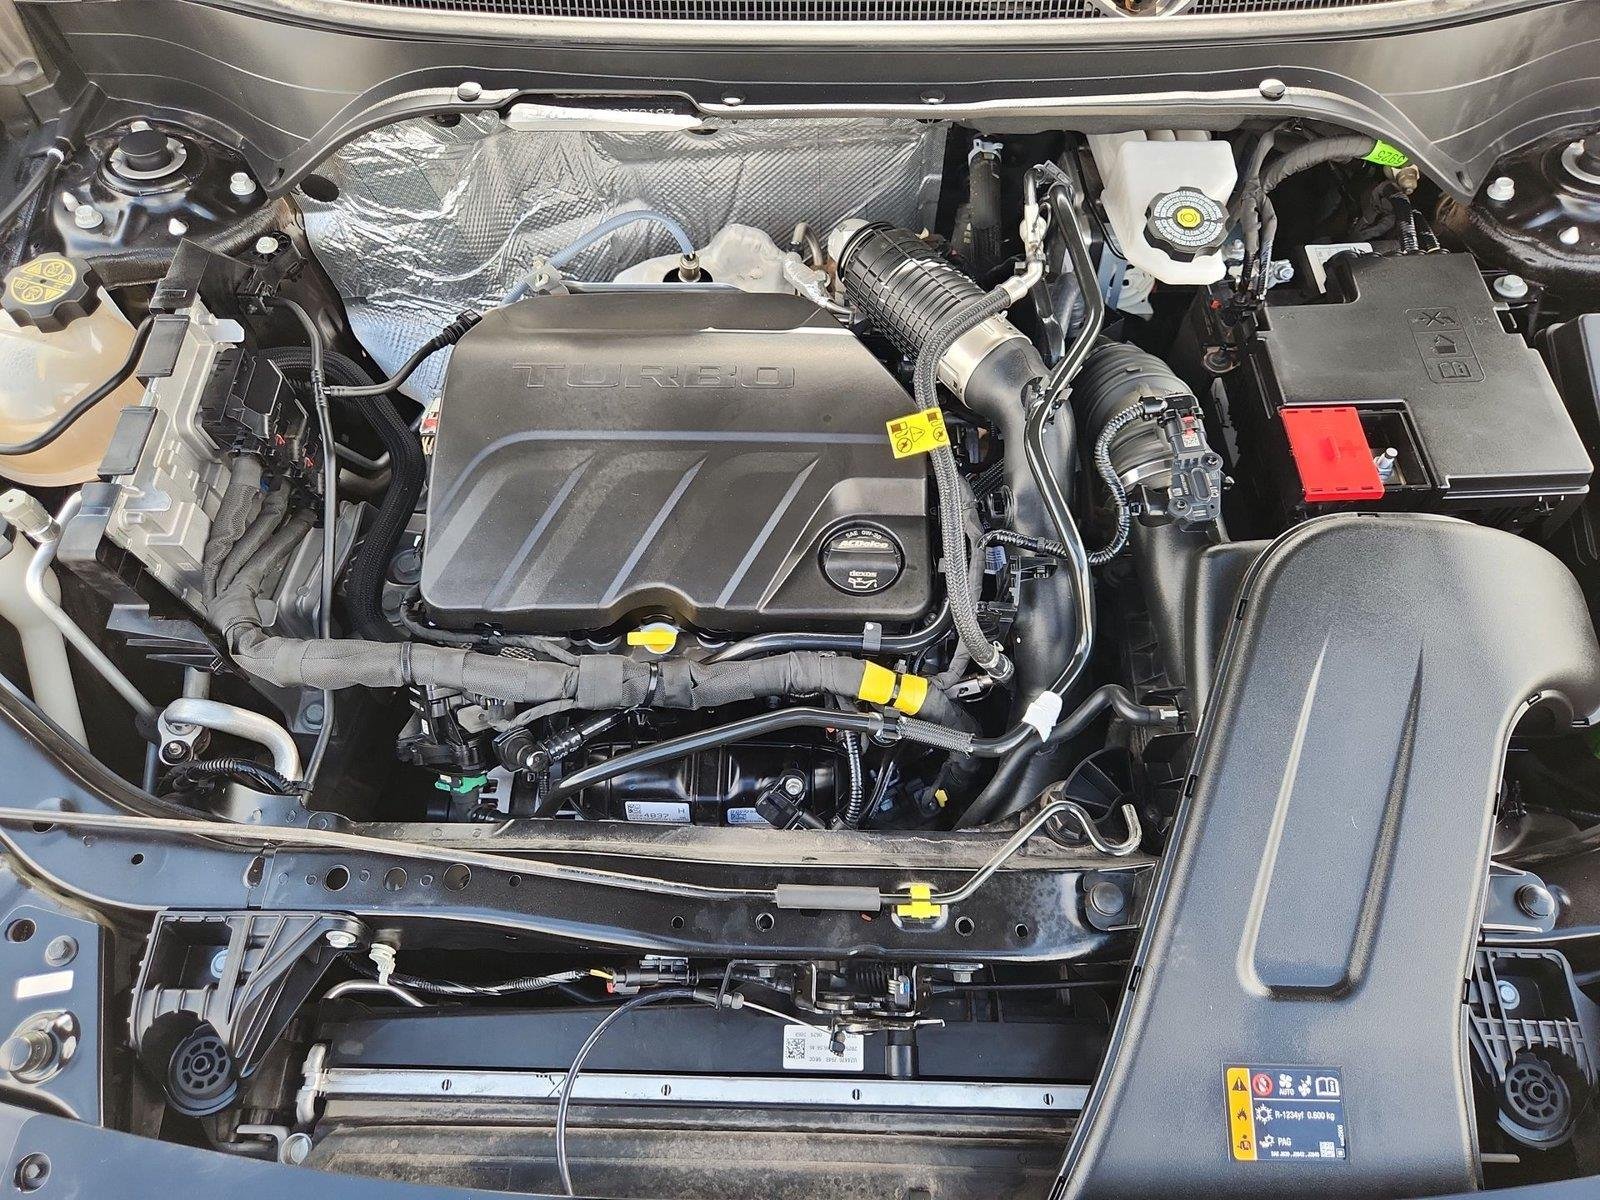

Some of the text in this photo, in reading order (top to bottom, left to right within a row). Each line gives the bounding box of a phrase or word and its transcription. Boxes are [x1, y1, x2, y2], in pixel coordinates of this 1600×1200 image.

[512, 361, 796, 389] TURBO
[845, 530, 882, 540] SAE 0W-20
[838, 540, 889, 549] ACDelco
[849, 570, 878, 578] dexos
[1279, 1088, 1295, 1096] AUTO
[1274, 1110, 1335, 1122] R-1234yf 0.600 kg
[1277, 1137, 1292, 1147] PAG
